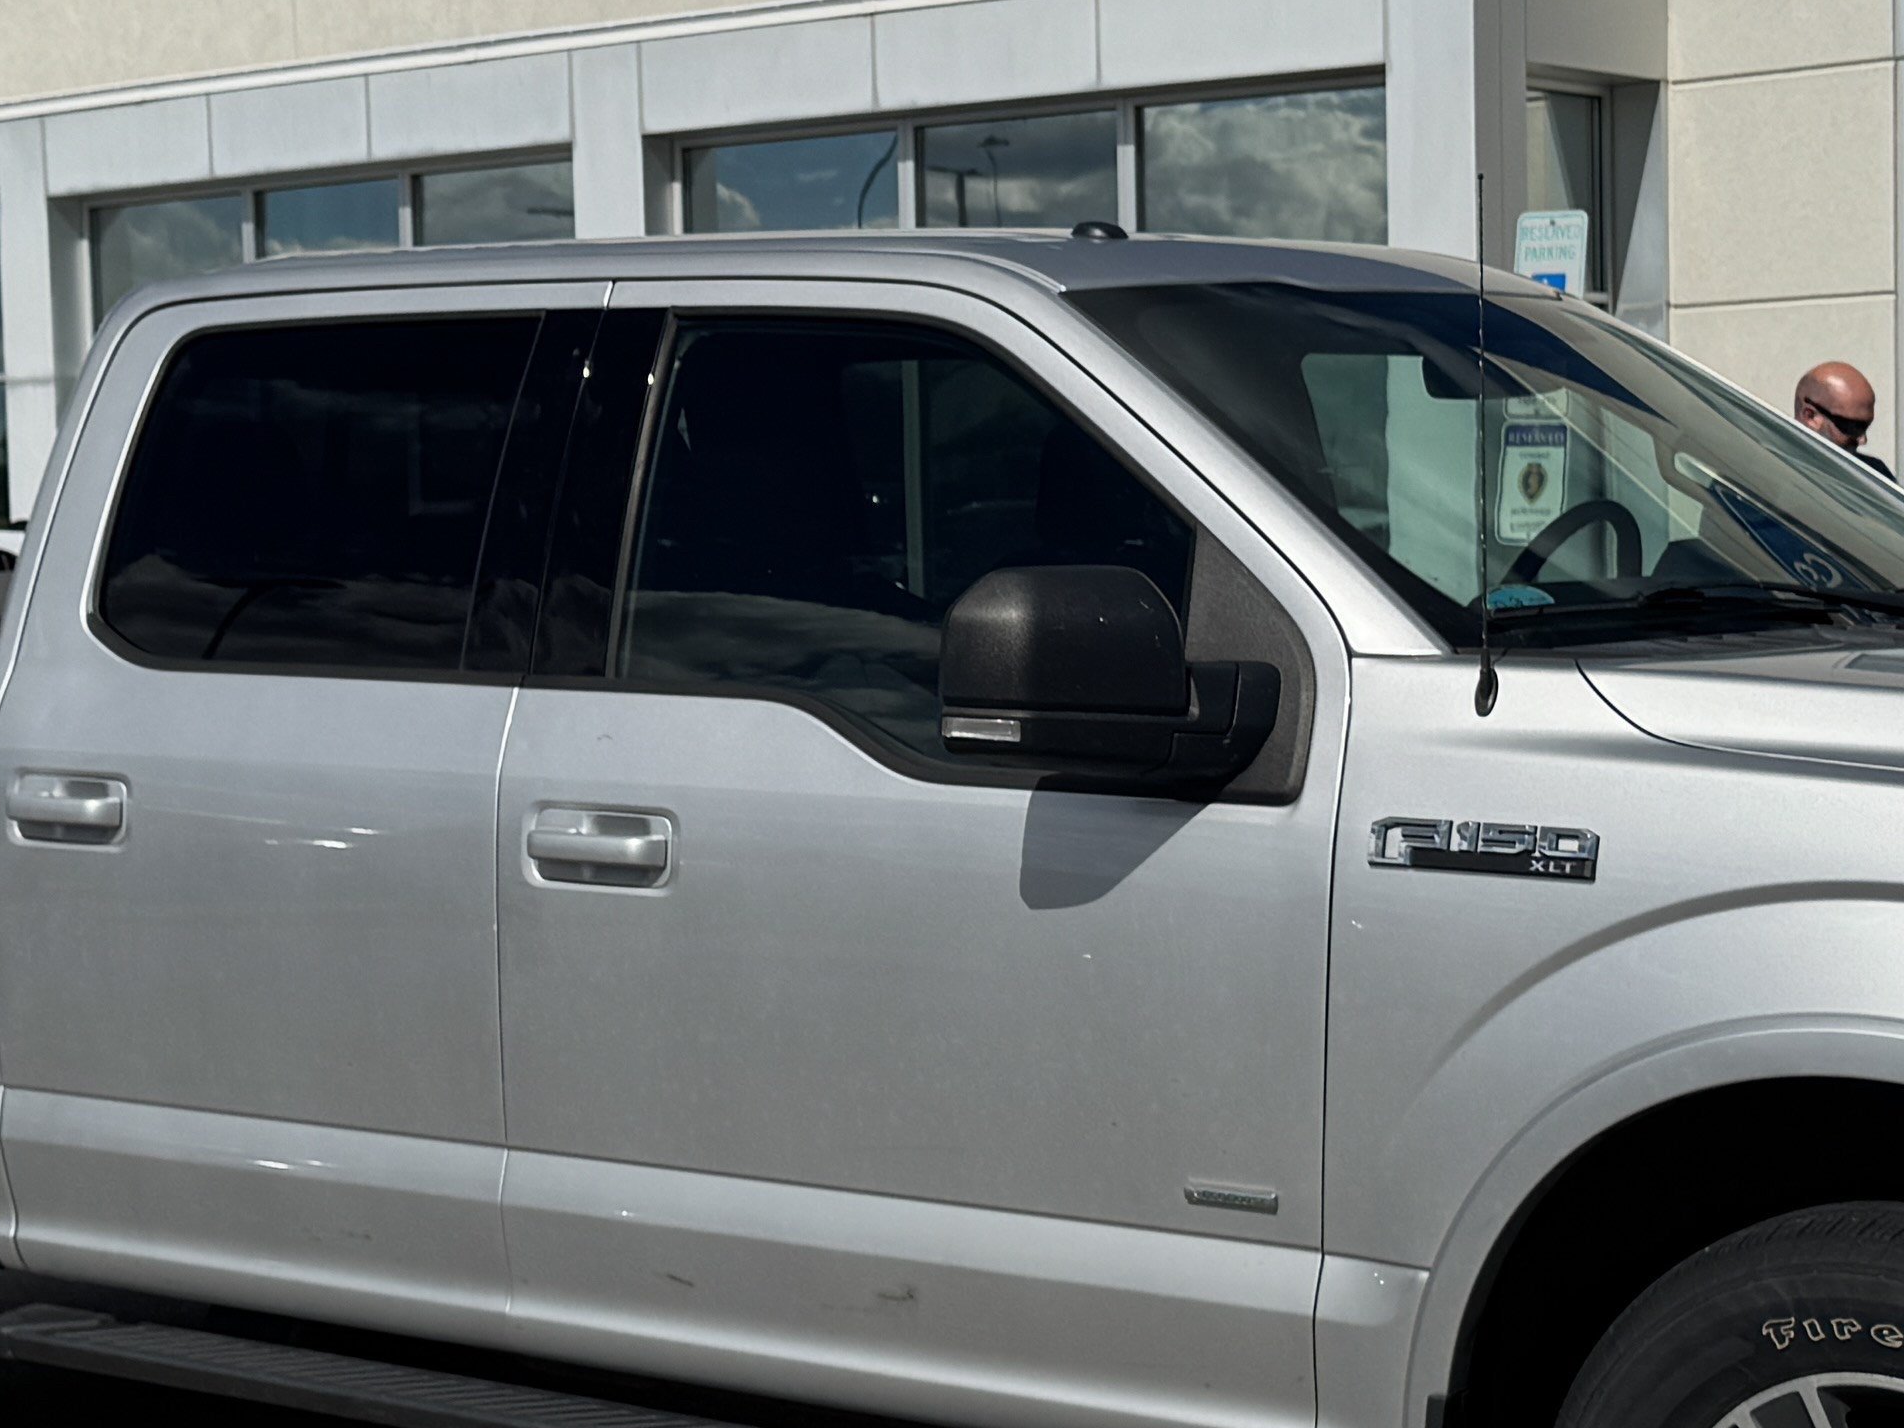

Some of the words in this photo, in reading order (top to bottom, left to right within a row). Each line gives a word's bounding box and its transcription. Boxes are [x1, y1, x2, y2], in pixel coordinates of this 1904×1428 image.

[1520, 225, 1584, 241] RESERVED
[1524, 246, 1577, 262] PARKING
[1528, 859, 1577, 875] XLT
